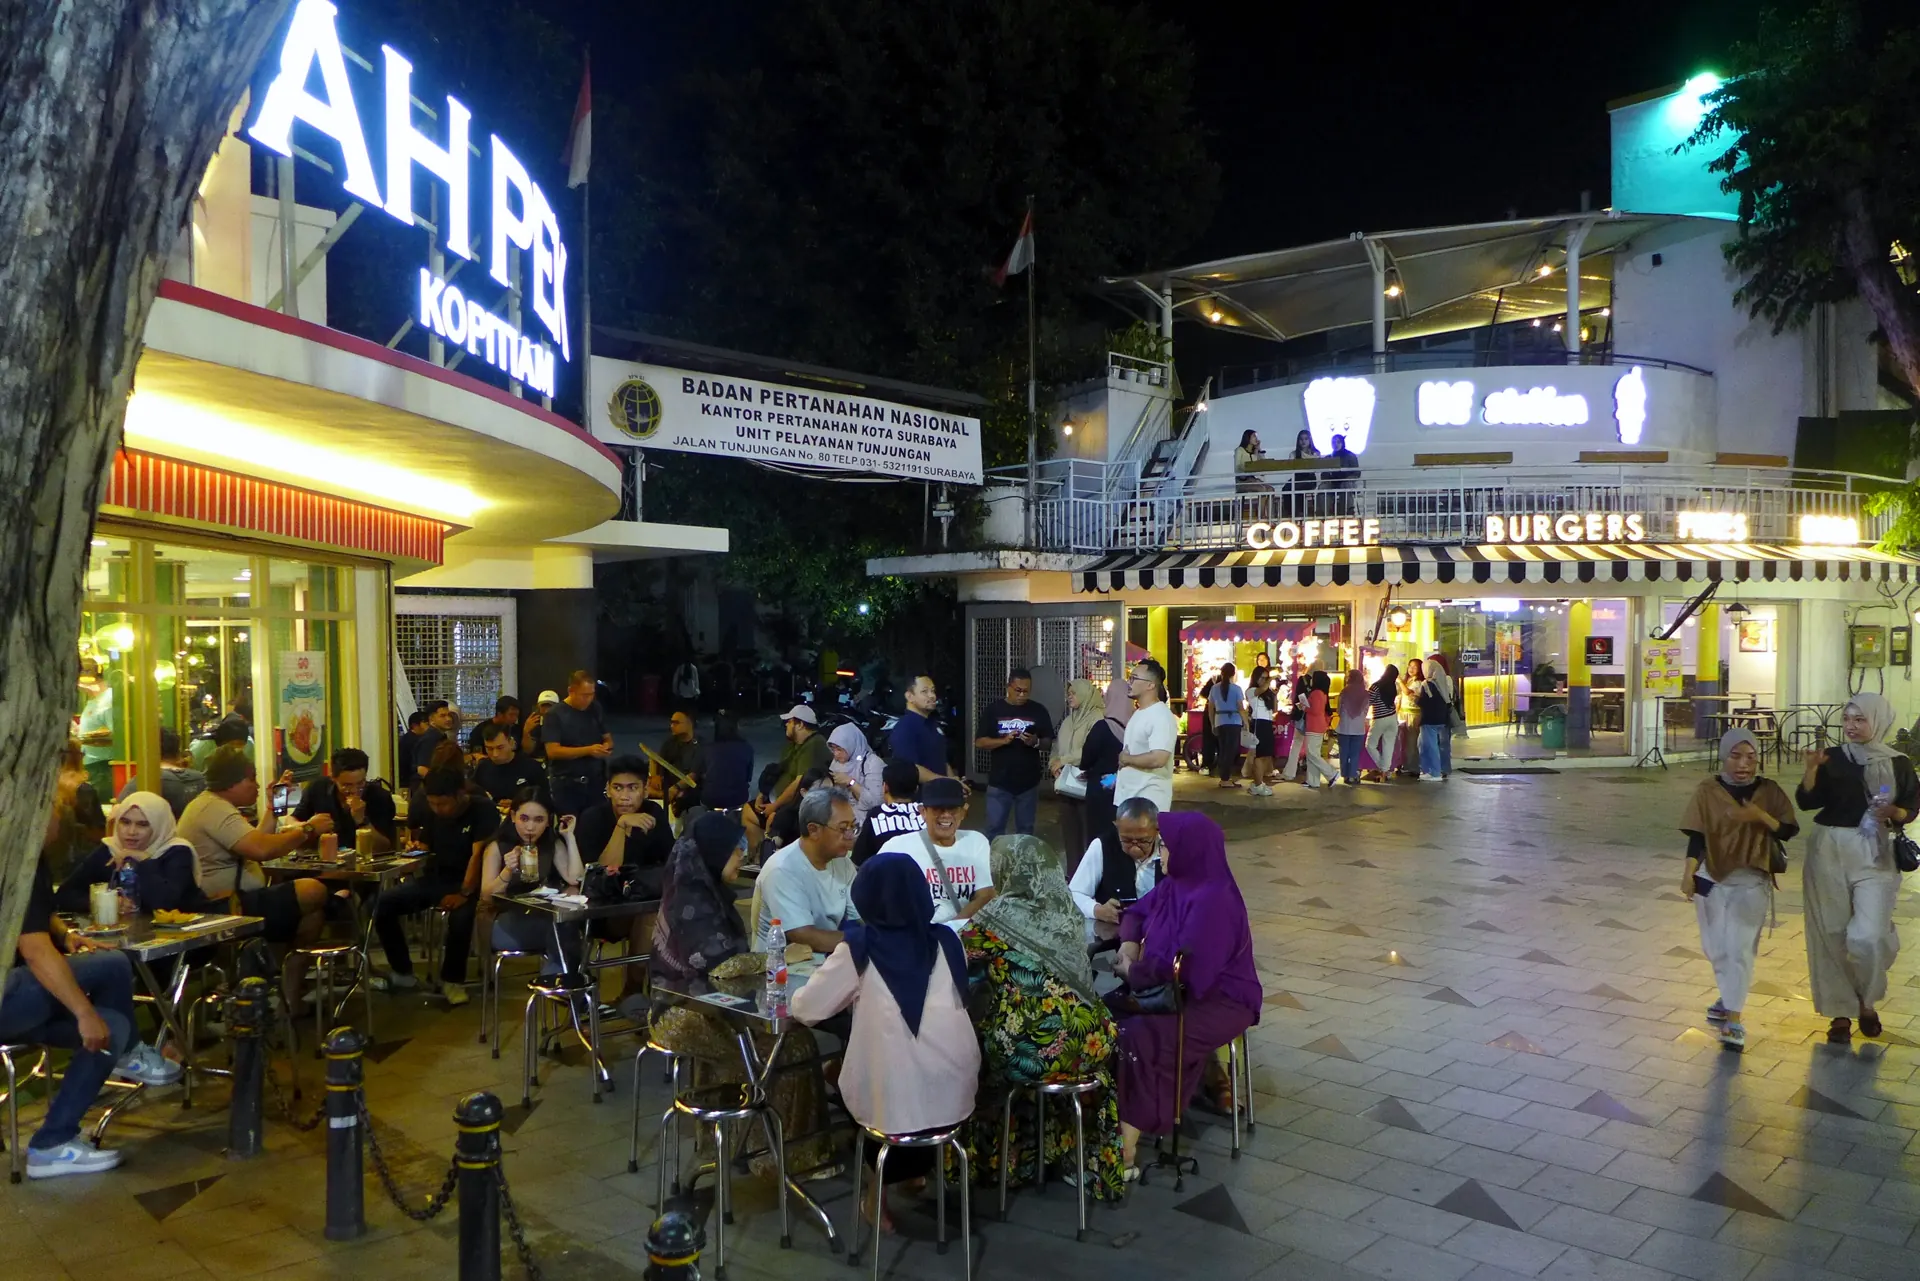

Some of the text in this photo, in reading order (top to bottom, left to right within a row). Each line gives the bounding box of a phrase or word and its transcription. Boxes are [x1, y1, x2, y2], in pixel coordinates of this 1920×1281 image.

[248, 0, 570, 363] AH PEK
[419, 267, 555, 399] KOPITIAM
[682, 377, 970, 437] BADAN PERTANAHAN NASIONAL
[701, 403, 957, 449] KANTOR PERTANAHAN KOTA SURABAYA
[672, 435, 716, 449] JALAN
[720, 440, 796, 458] TUNJUNGAN
[818, 452, 830, 462] 80
[883, 460, 922, 474] 5321191
[923, 466, 976, 481] SURABAYA
[736, 425, 931, 462] UNIT PELAYANAN TUNJUNGAN
[1246, 519, 1380, 549] COFFEE
[1485, 514, 1644, 544] BURGERS
[1462, 653, 1480, 662] OPEN
